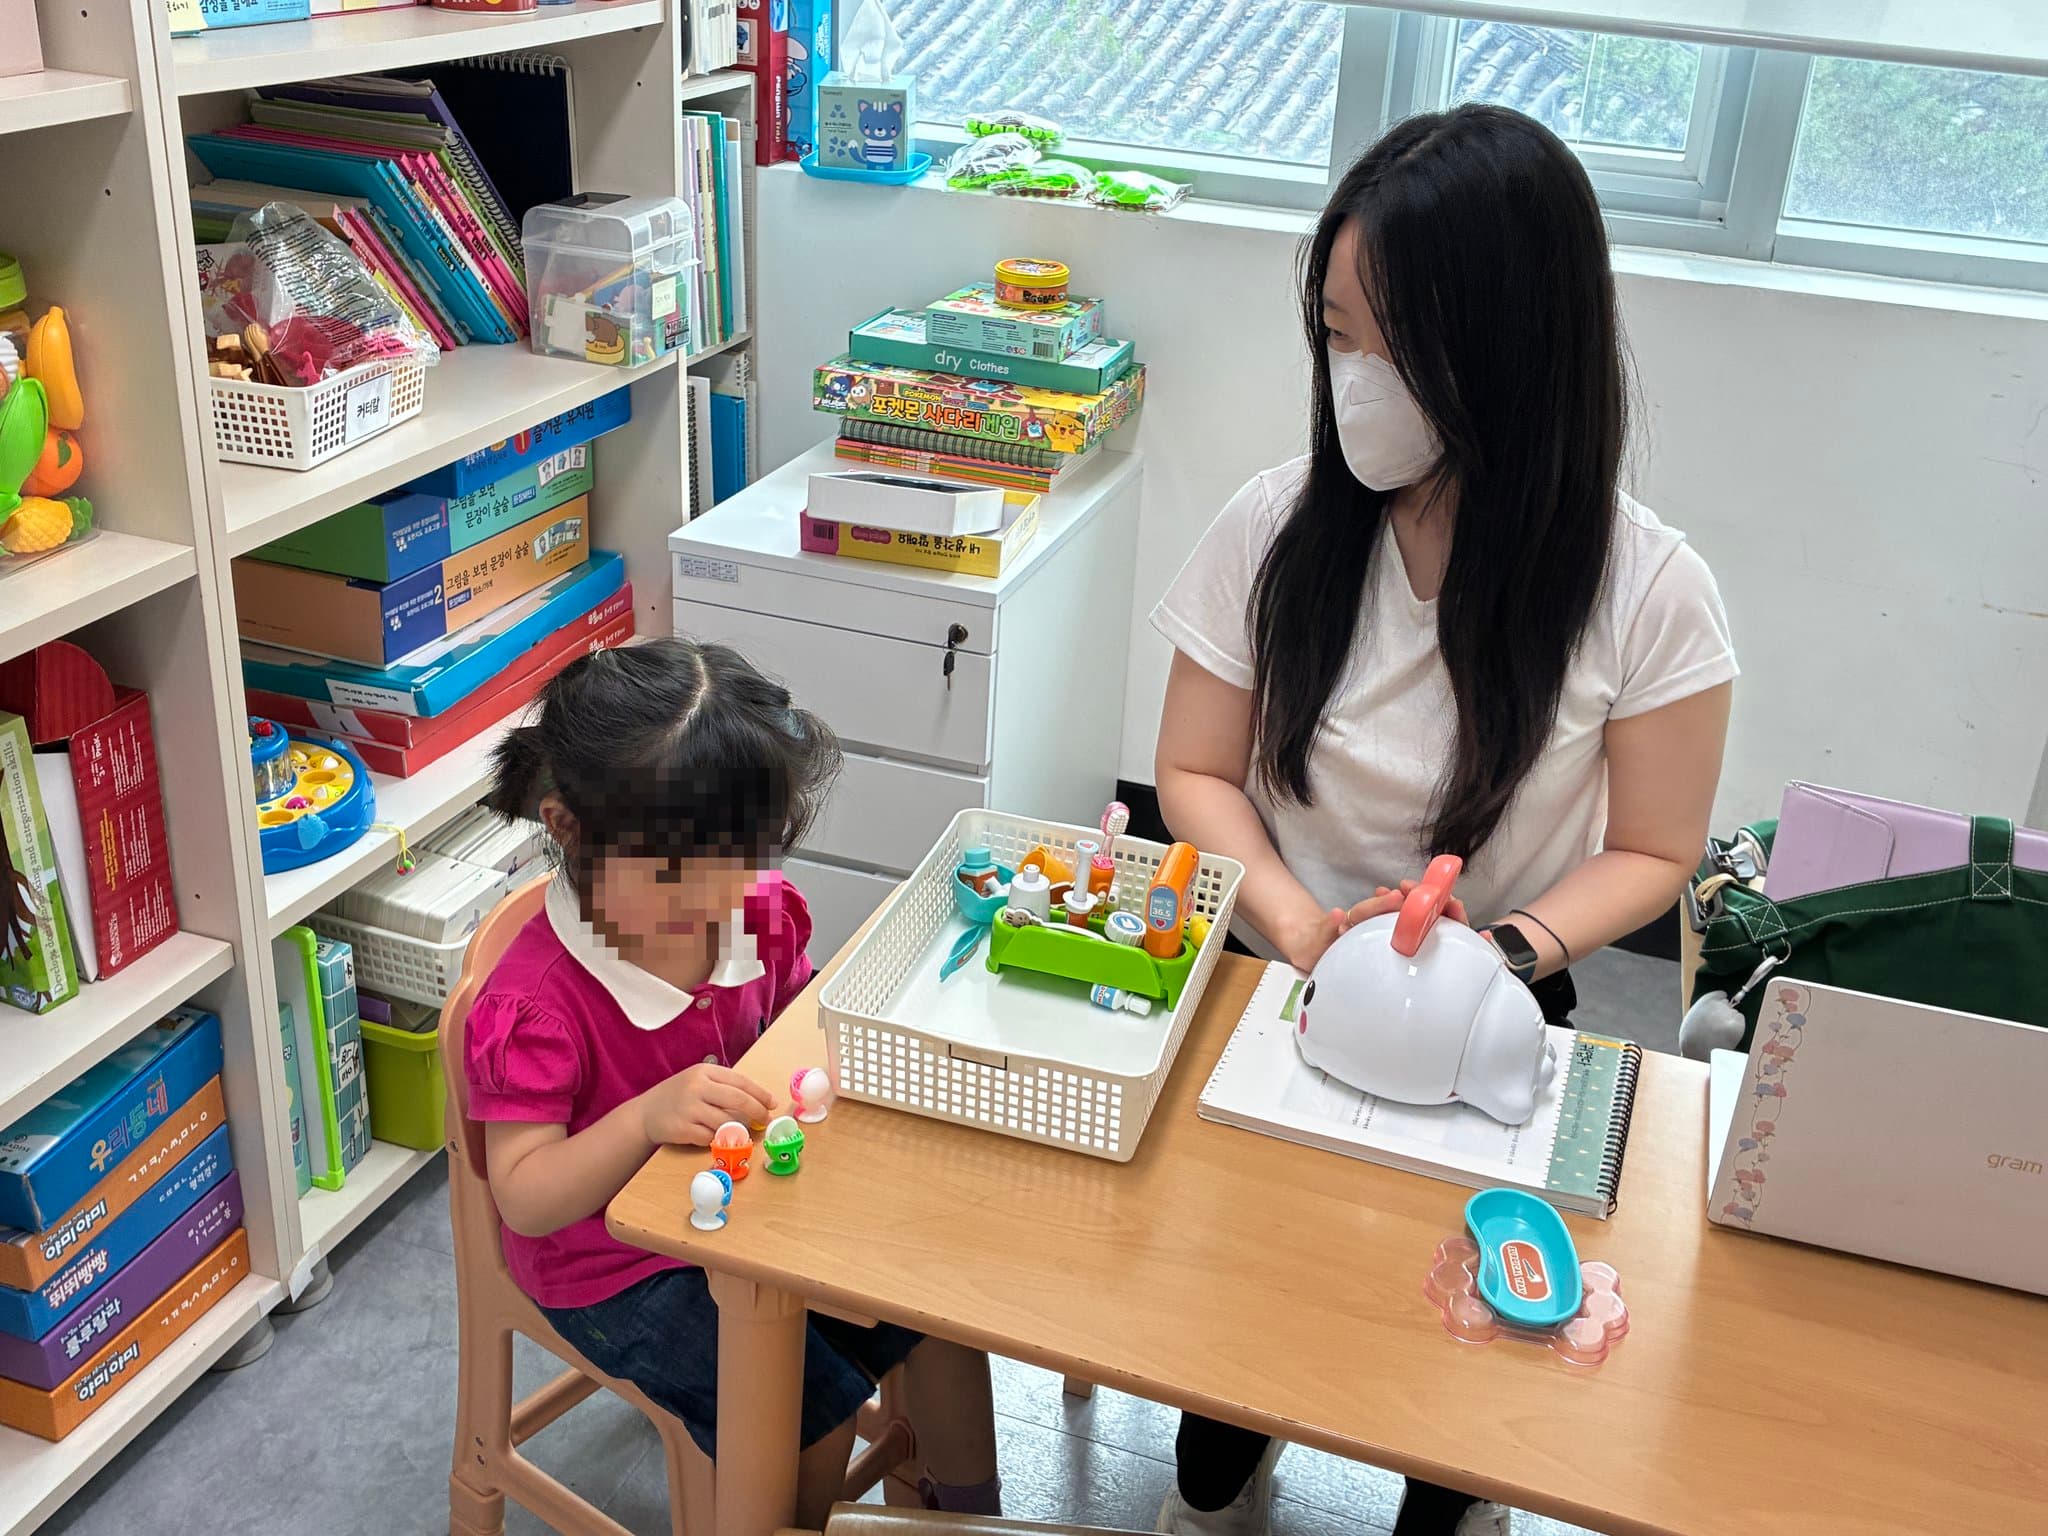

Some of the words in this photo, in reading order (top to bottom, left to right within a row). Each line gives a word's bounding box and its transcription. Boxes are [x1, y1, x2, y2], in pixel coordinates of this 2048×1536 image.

[935, 349, 962, 373] dry
[970, 355, 1009, 375] Clothes
[871, 394, 921, 422] 포켓몬
[923, 403, 1021, 439] 사다리게임
[465, 503, 491, 529] 문장이
[492, 496, 510, 517] 술술
[897, 534, 929, 547] 말해요
[933, 536, 967, 554] 생각을
[970, 543, 981, 555] 내
[446, 568, 471, 591] 그림을
[473, 560, 489, 578] 보면
[490, 547, 513, 571] 문장이
[514, 540, 530, 560] 술술
[433, 584, 444, 605] 2
[4, 740, 18, 769] skills
[12, 770, 33, 844] categorization
[25, 846, 36, 868] and
[46, 945, 64, 997] Develops
[89, 1080, 169, 1172] 우리동네
[1987, 1154, 2043, 1175] gram
[44, 1199, 108, 1261] 야미야미
[49, 1250, 109, 1309] 뛰뛰빵빵
[77, 1340, 140, 1401] 야미야미
